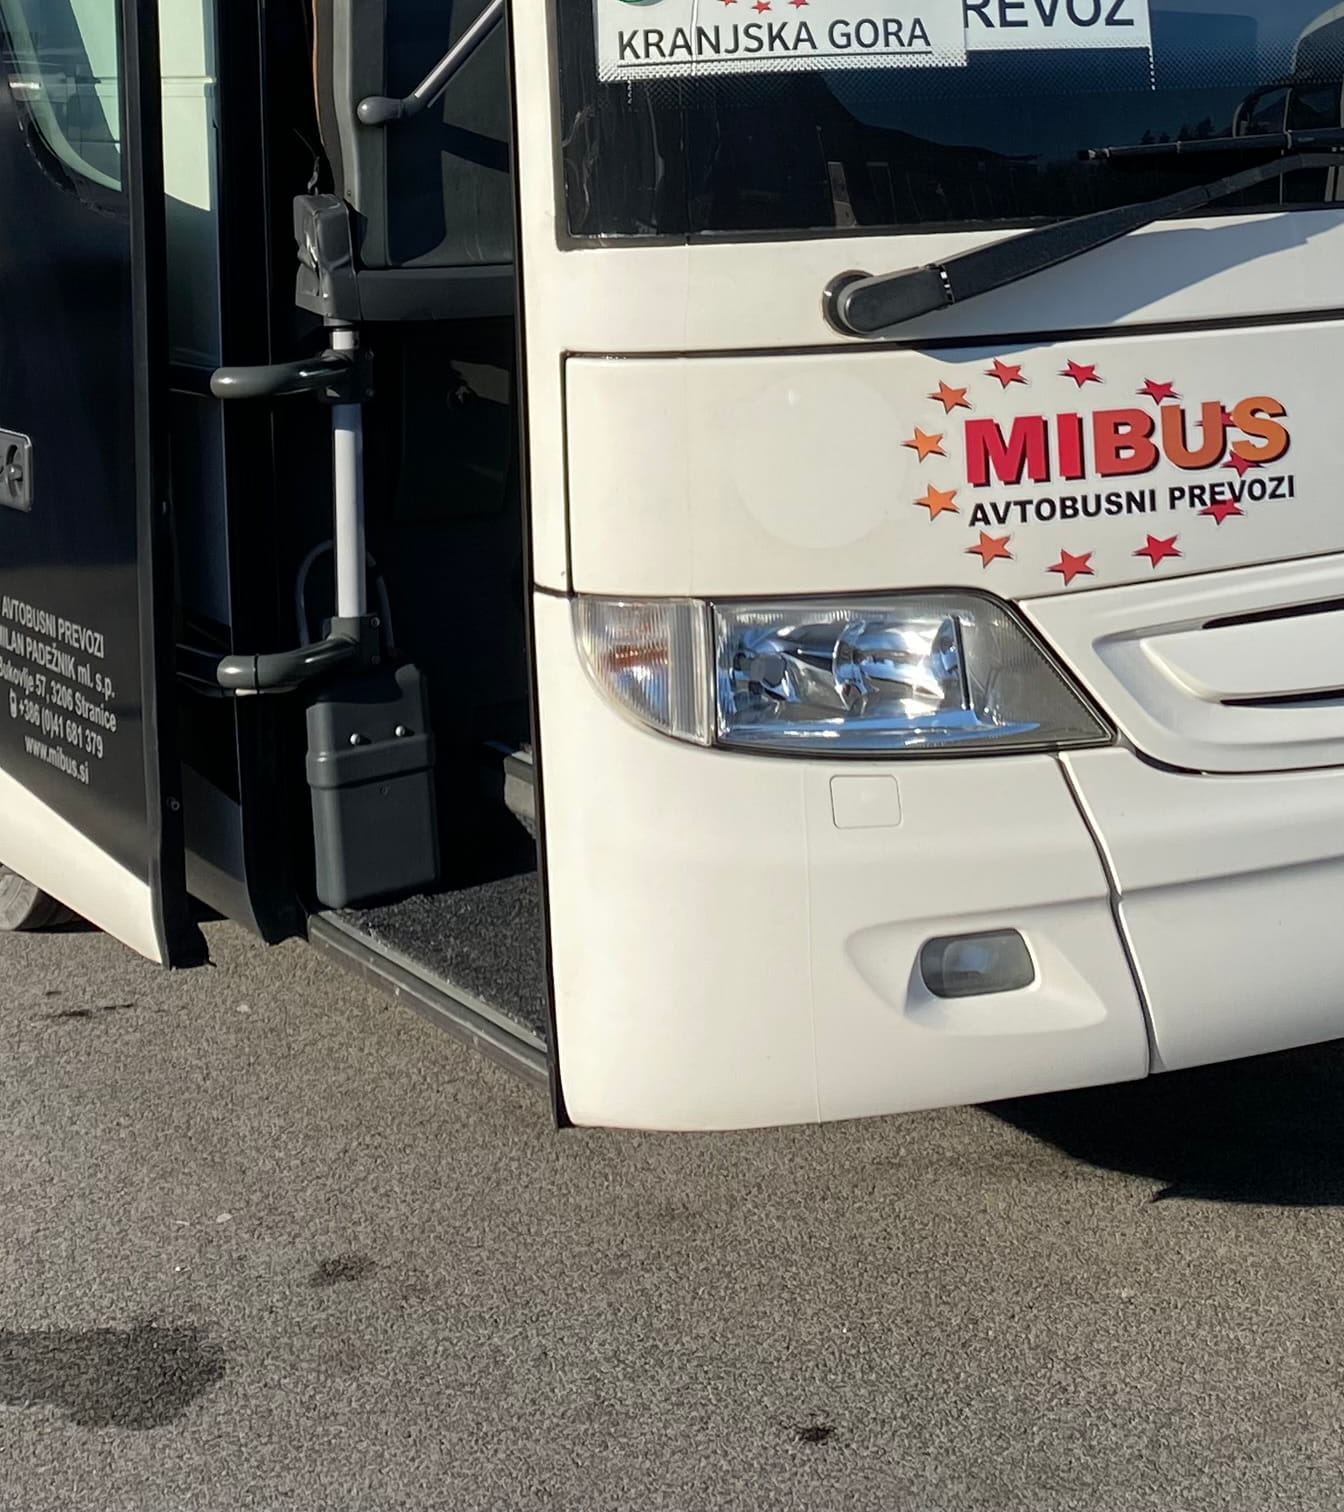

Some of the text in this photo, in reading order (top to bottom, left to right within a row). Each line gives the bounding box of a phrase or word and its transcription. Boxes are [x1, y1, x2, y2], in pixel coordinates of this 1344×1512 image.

[617, 17, 932, 61] KRANJSKA GORA
[964, 395, 1291, 488] MIBUS
[968, 474, 1295, 527] AVTOBUSNI PREVOZI
[1, 594, 105, 659] AVTOBUSNI PREVOZI
[25, 636, 76, 681] PADEŽNIK
[95, 673, 115, 701] s.p.
[18, 698, 104, 759] +386 (0)41 681 379
[50, 679, 74, 711] 3206
[75, 691, 117, 732] Stranice
[24, 735, 90, 785] www.mibus.si
